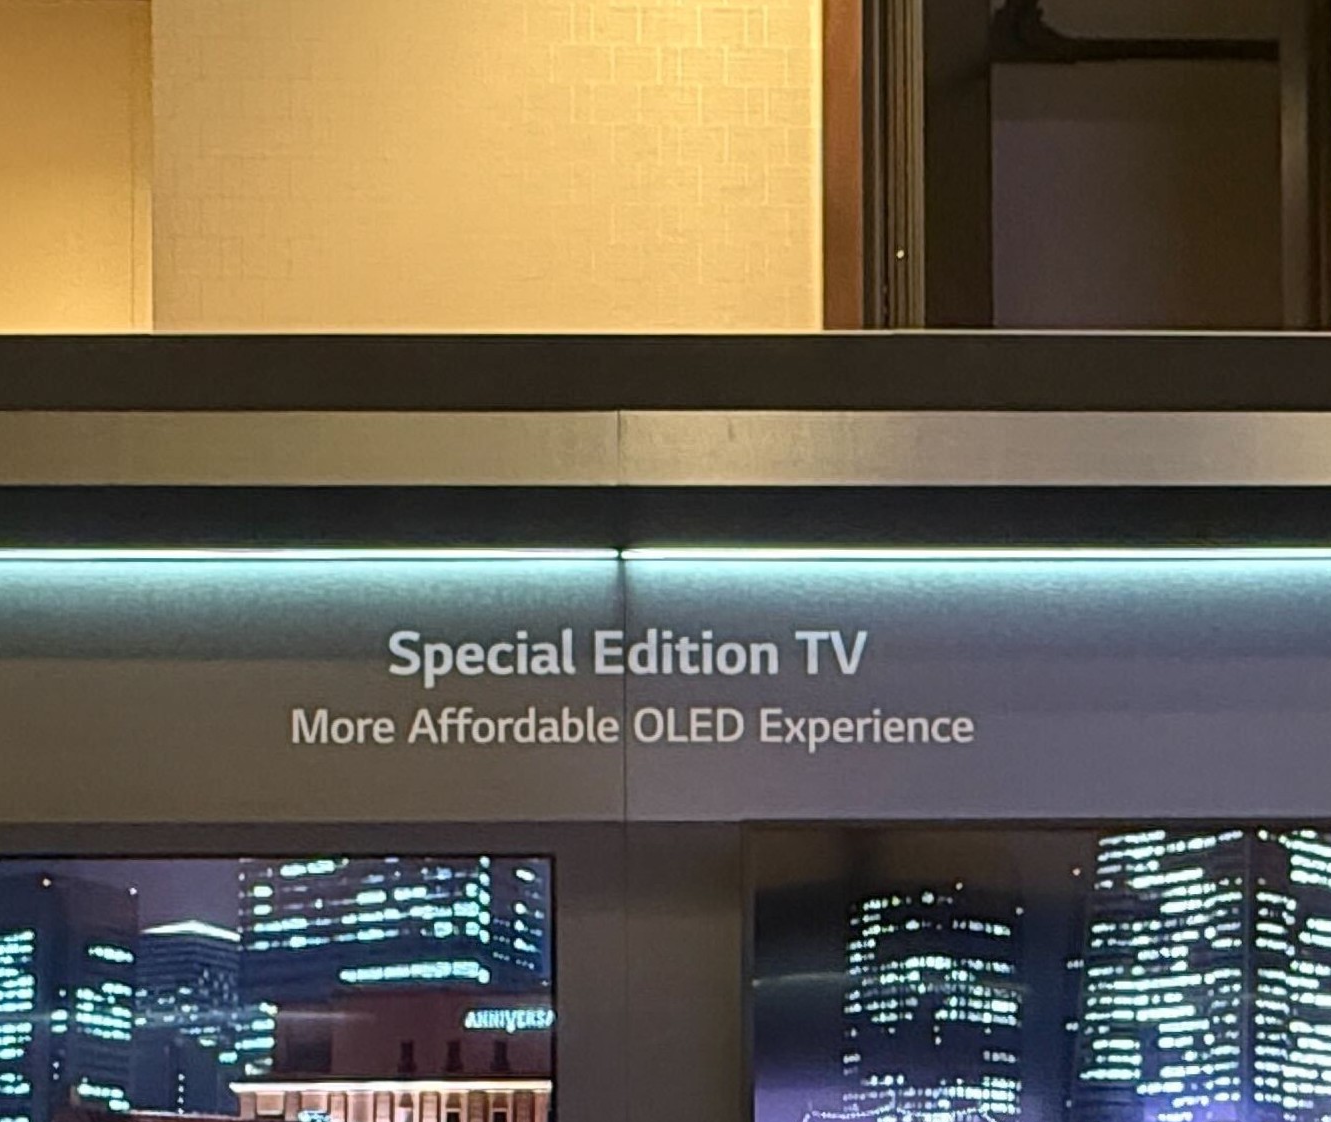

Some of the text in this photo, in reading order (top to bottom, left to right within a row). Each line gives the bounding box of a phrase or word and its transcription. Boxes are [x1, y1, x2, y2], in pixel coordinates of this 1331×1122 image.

[388, 628, 868, 689] Special Edition TV
[290, 706, 975, 754] More Affordable OLED Experience
